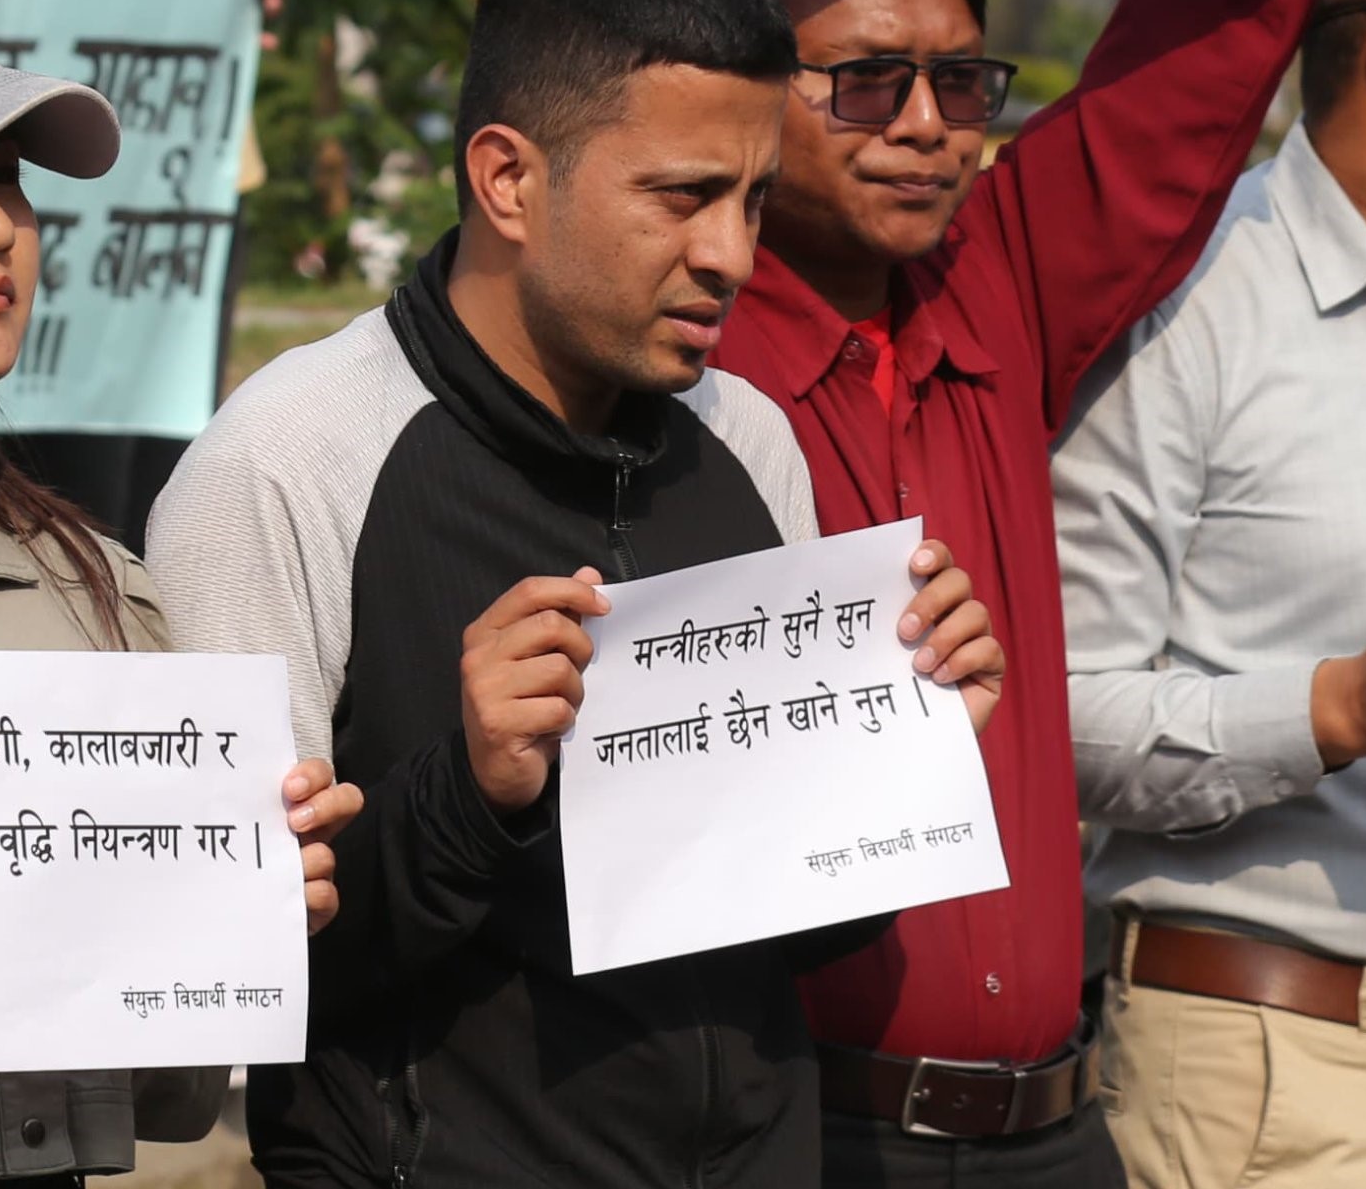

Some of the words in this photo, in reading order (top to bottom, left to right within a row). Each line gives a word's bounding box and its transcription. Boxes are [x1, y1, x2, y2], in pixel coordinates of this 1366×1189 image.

[633, 606, 770, 669] मन्त्रीहरुको
[781, 590, 824, 658] सुनै
[834, 599, 875, 649] सुन
[44, 718, 203, 768] कालाबजारी
[216, 732, 237, 768] र
[593, 703, 712, 766] जनतालाई
[723, 689, 770, 749] छैन
[782, 681, 838, 731] खाने
[849, 684, 896, 733] नुन
[70, 809, 182, 860] नियन्त्रण
[194, 825, 236, 861] गर
[805, 848, 852, 876] संयुक्त
[858, 828, 915, 860] विद्यार्थी
[922, 822, 973, 845] संगठन
[121, 986, 166, 1018] संयुक्त
[174, 982, 226, 1008] विद्यार्थी
[234, 984, 283, 1007] संगठन
